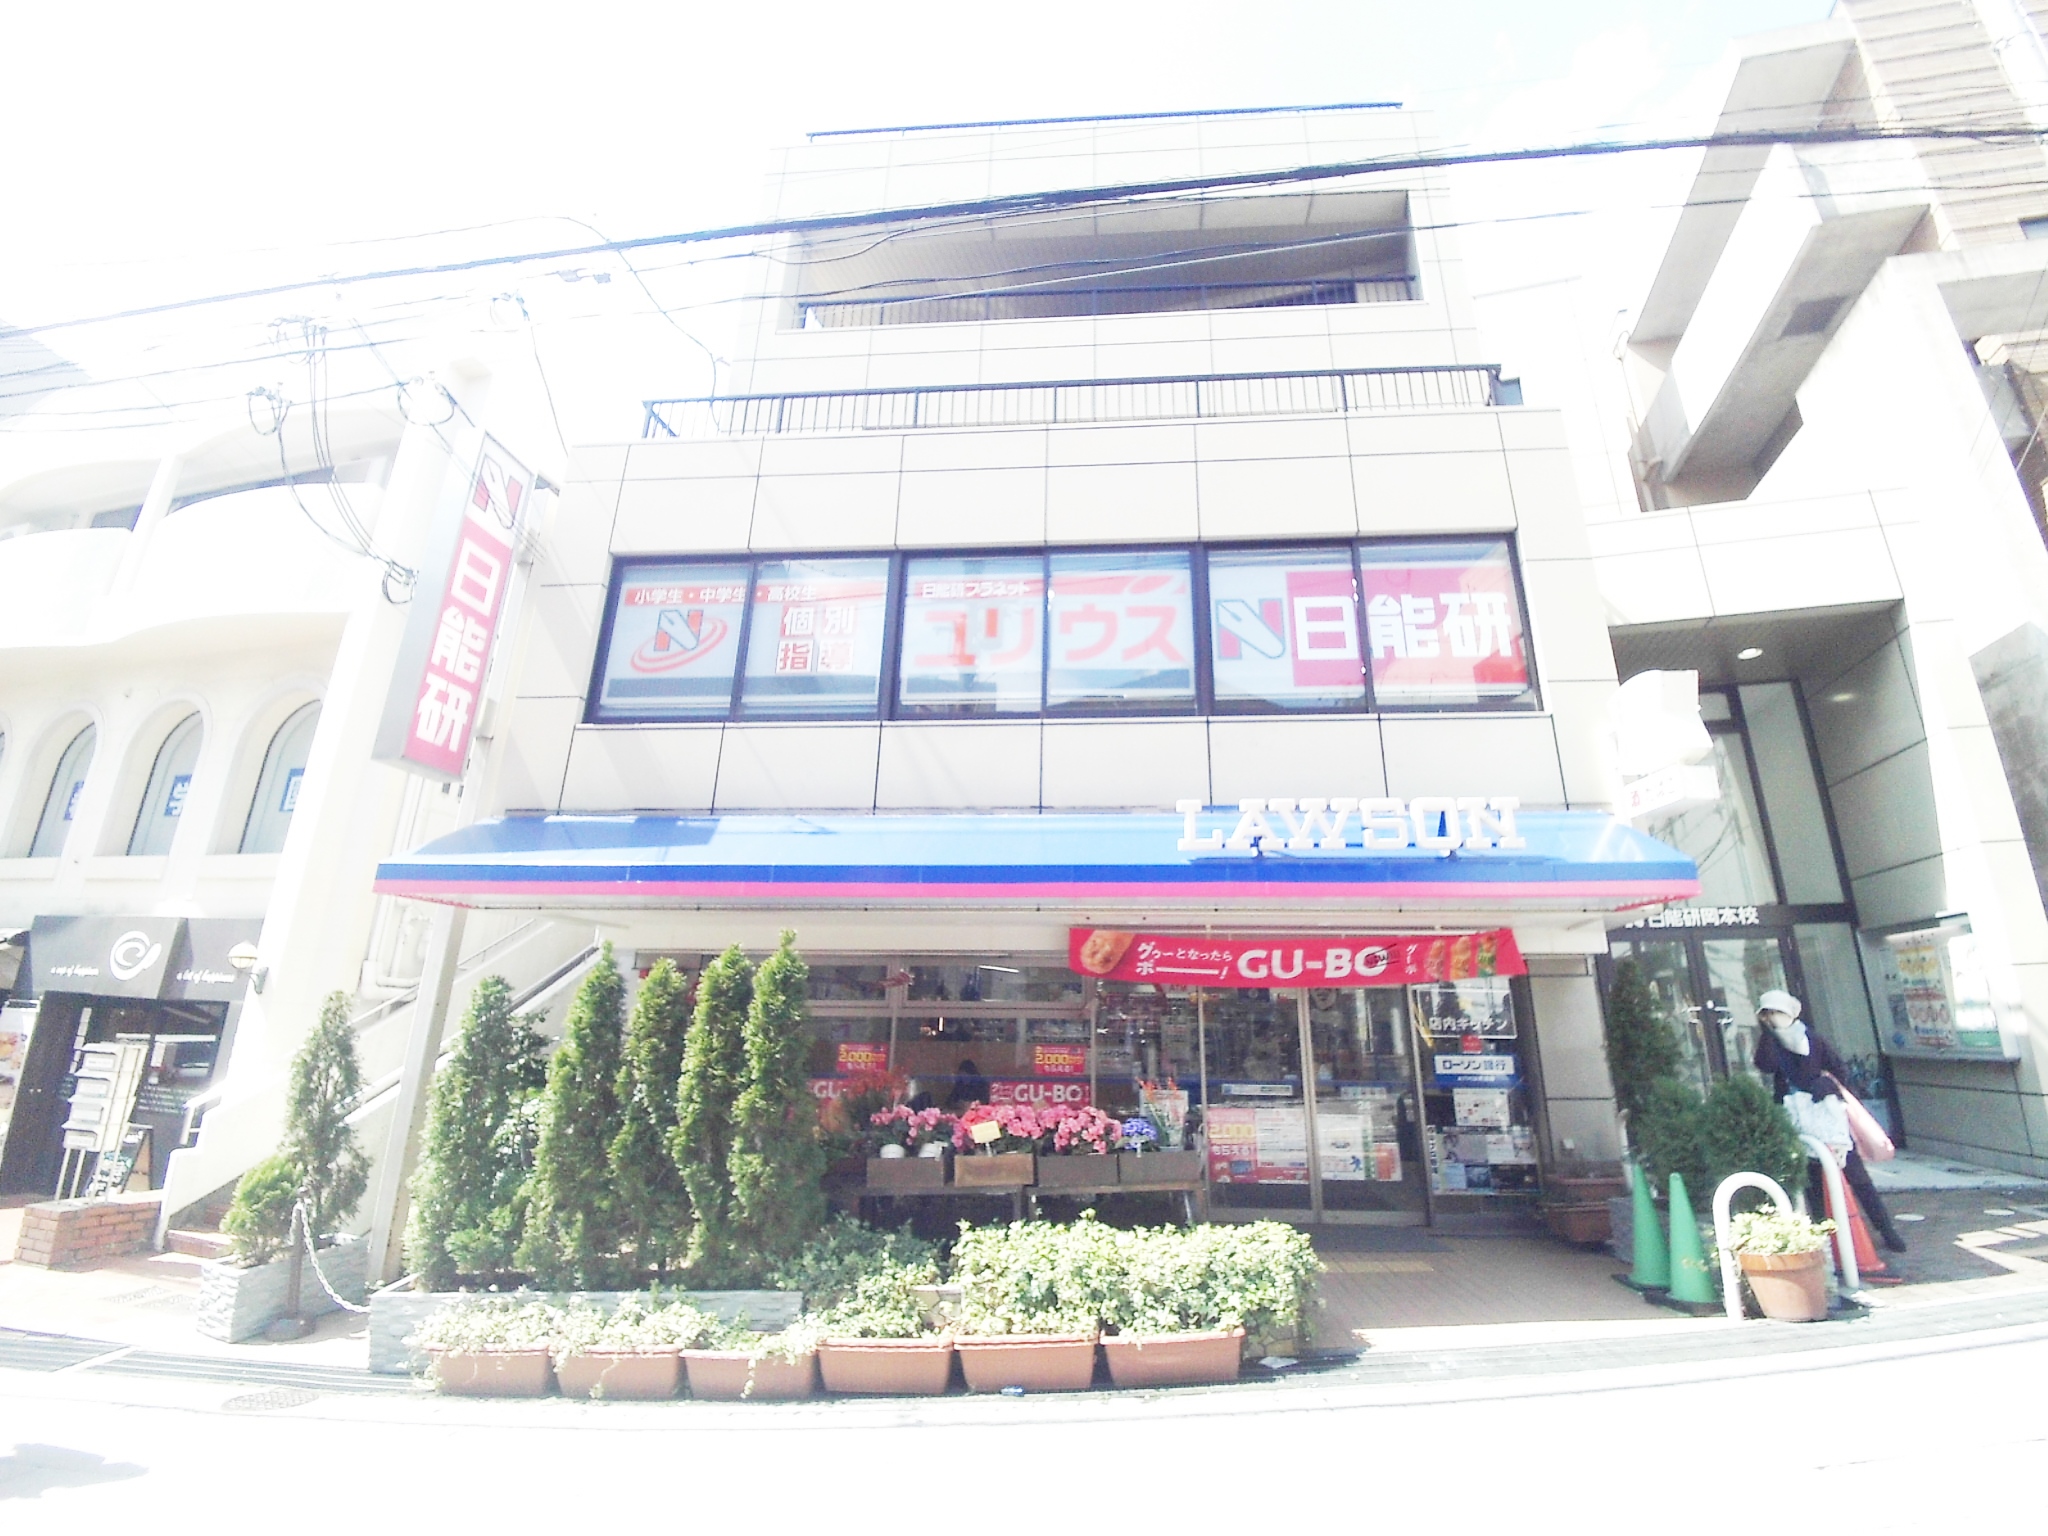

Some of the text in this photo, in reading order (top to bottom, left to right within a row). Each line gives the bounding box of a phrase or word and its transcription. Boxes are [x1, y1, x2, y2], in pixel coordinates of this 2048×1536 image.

[784, 606, 856, 636] 個別
[913, 603, 1189, 667] ユリウス
[1293, 591, 1514, 660] 日能研
[415, 537, 502, 753] 日能研
[1175, 796, 1527, 852] LAWSON
[1237, 946, 1388, 979] GU-BO
[1429, 1016, 1508, 1031] 店内キッチン
[1014, 1083, 1083, 1103] GU-BO
